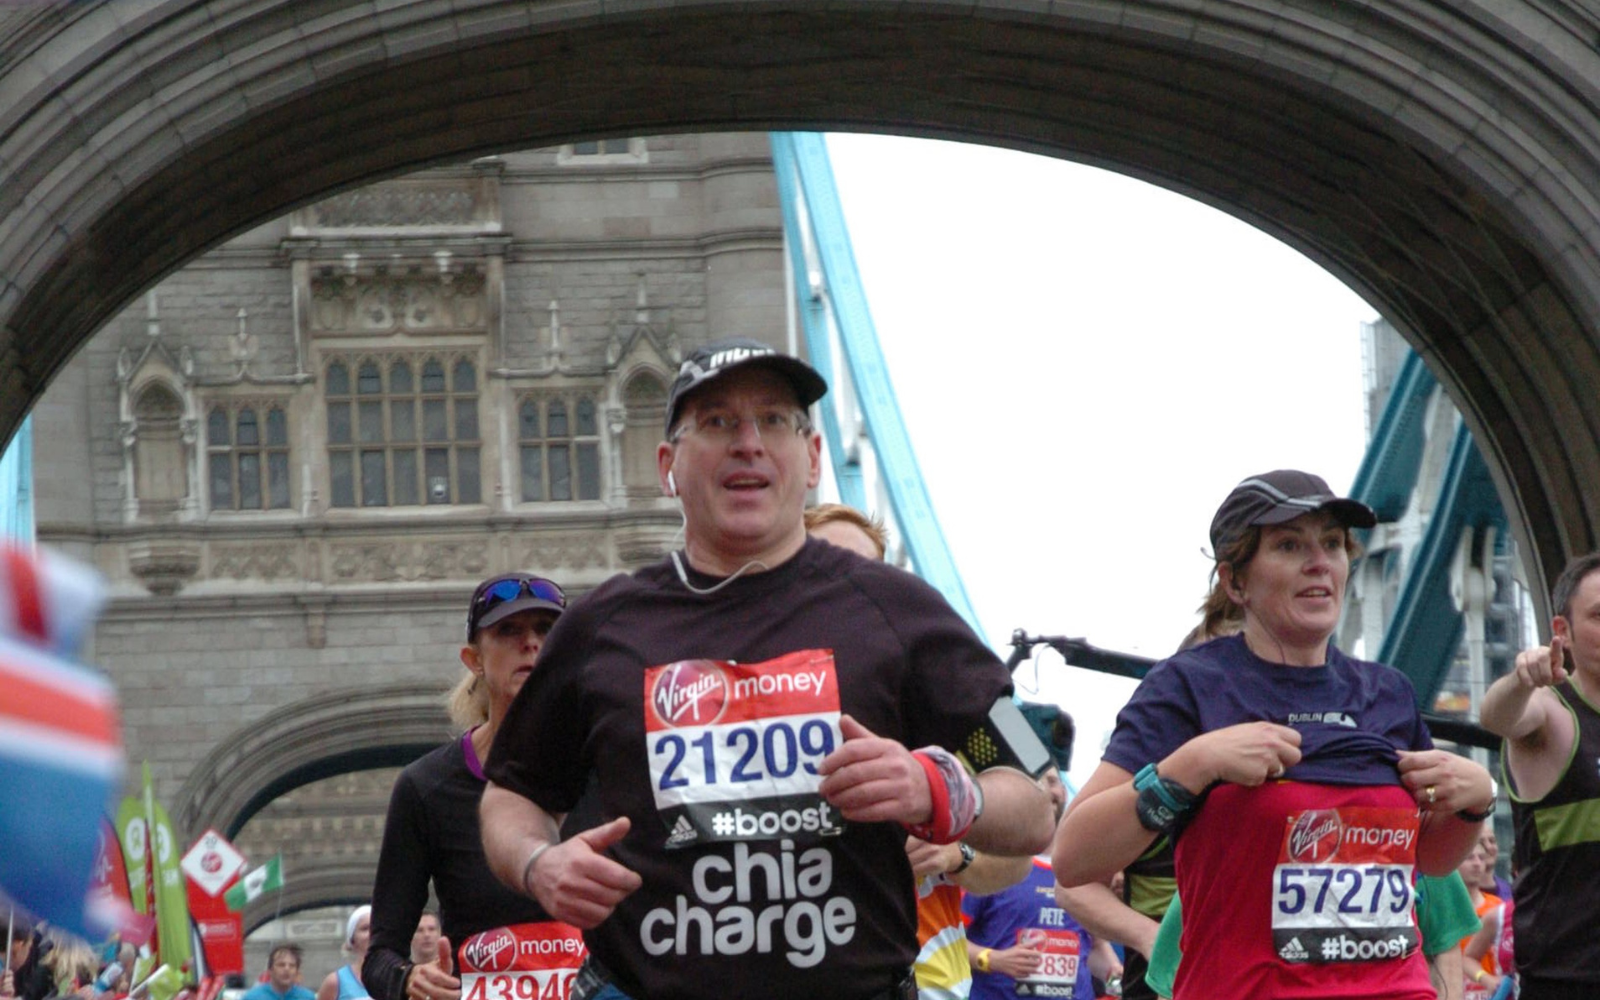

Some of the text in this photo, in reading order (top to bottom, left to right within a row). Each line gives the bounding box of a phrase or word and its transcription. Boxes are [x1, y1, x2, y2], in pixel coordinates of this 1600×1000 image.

[657, 664, 826, 722] Virgin money
[1288, 712, 1323, 723] DUBLIN
[655, 719, 835, 791] 21209
[712, 802, 833, 836] #boost
[1292, 812, 1415, 860] Virgin money
[692, 839, 833, 904] chia
[1278, 868, 1410, 914] 57279
[640, 894, 857, 969] charge
[1039, 906, 1065, 926] PETE
[467, 931, 585, 970] Virgin money
[1321, 934, 1410, 961] #boost
